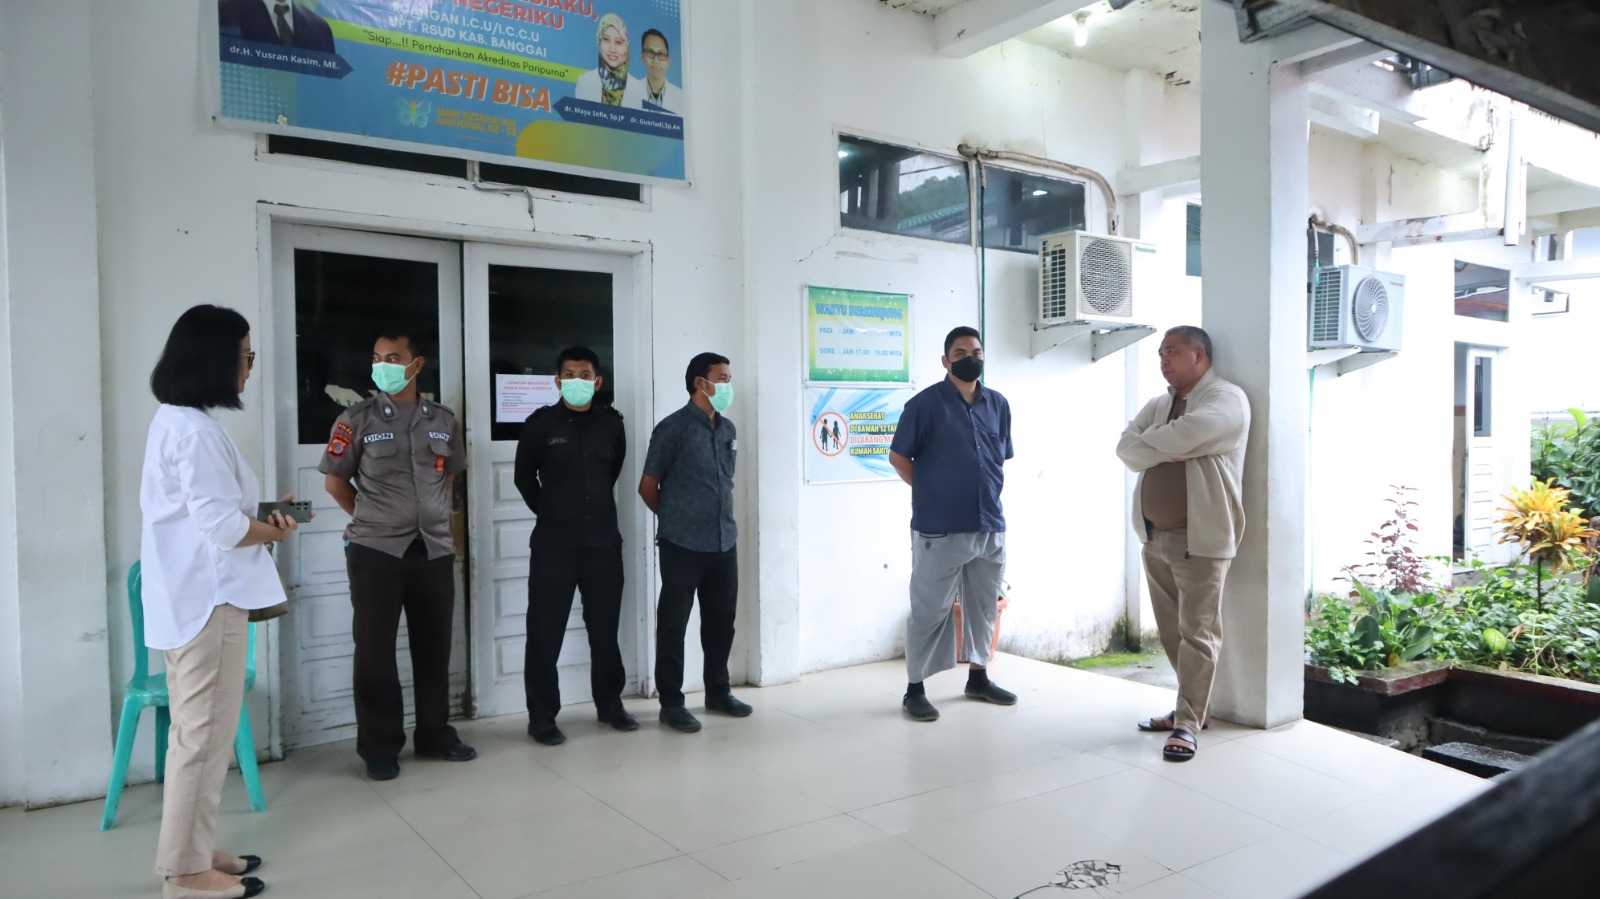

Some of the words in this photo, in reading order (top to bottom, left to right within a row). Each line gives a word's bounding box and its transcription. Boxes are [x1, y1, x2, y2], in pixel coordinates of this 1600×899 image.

[462, 16, 540, 42] I.C.U/I.C.C.U
[389, 15, 418, 32] UPT.
[421, 22, 456, 38] RSUD
[459, 29, 488, 45] KAB.
[491, 36, 547, 58] BANGGAI
[255, 49, 289, 61] Yusran
[290, 55, 321, 68] Kasim,
[323, 60, 340, 70] ME.
[411, 39, 475, 60] Pertahankan
[477, 52, 521, 69] Akreditas
[385, 60, 488, 101] #PASTI
[492, 79, 552, 112] BISA
[574, 107, 591, 117] Maya
[815, 303, 847, 317] WAKTU
[849, 305, 903, 321] BERKUNJUNG
[850, 412, 866, 420] ANAK
[867, 412, 885, 420] SEHAT
[850, 425, 856, 433] DI
[857, 424, 879, 433] BAWAH
[366, 433, 391, 441] DION
[850, 435, 883, 444] DILARANG
[850, 447, 871, 455] RUMAH
[872, 446, 889, 455] SAKIT
